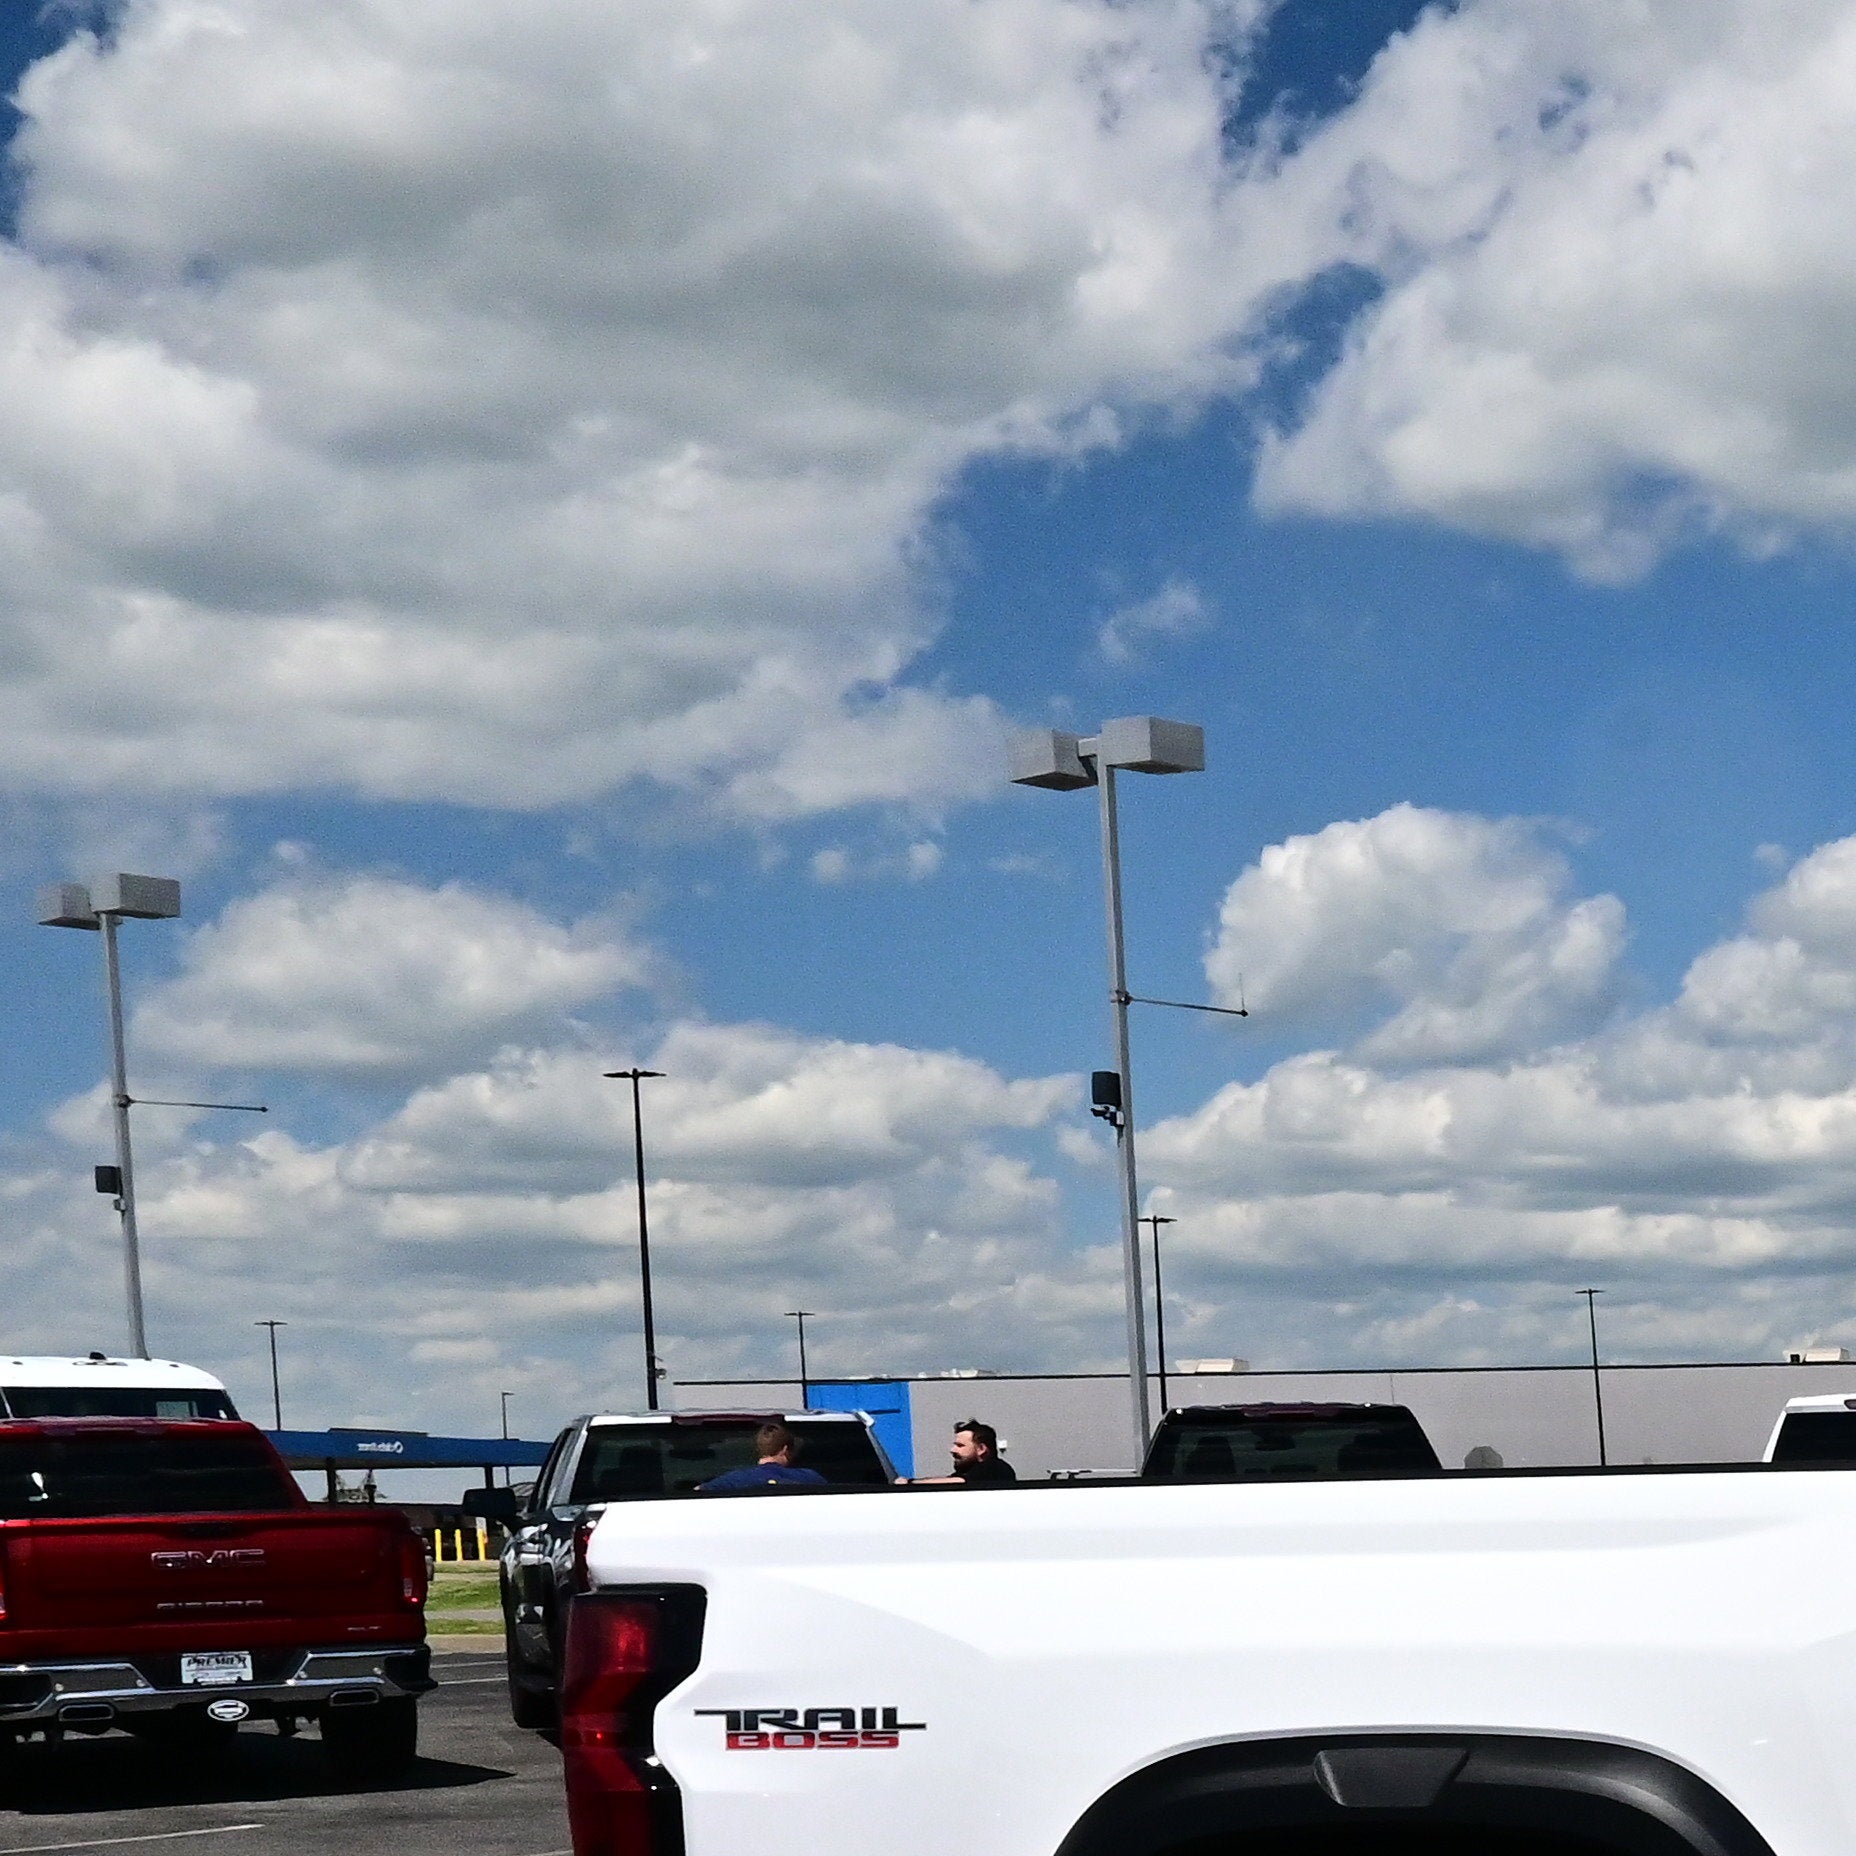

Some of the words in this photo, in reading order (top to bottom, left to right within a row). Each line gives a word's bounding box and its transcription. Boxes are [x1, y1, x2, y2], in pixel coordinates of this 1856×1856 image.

[150, 1548, 265, 1569] GMC
[693, 1706, 928, 1731] TRAIL
[725, 1731, 900, 1750] BOSS
